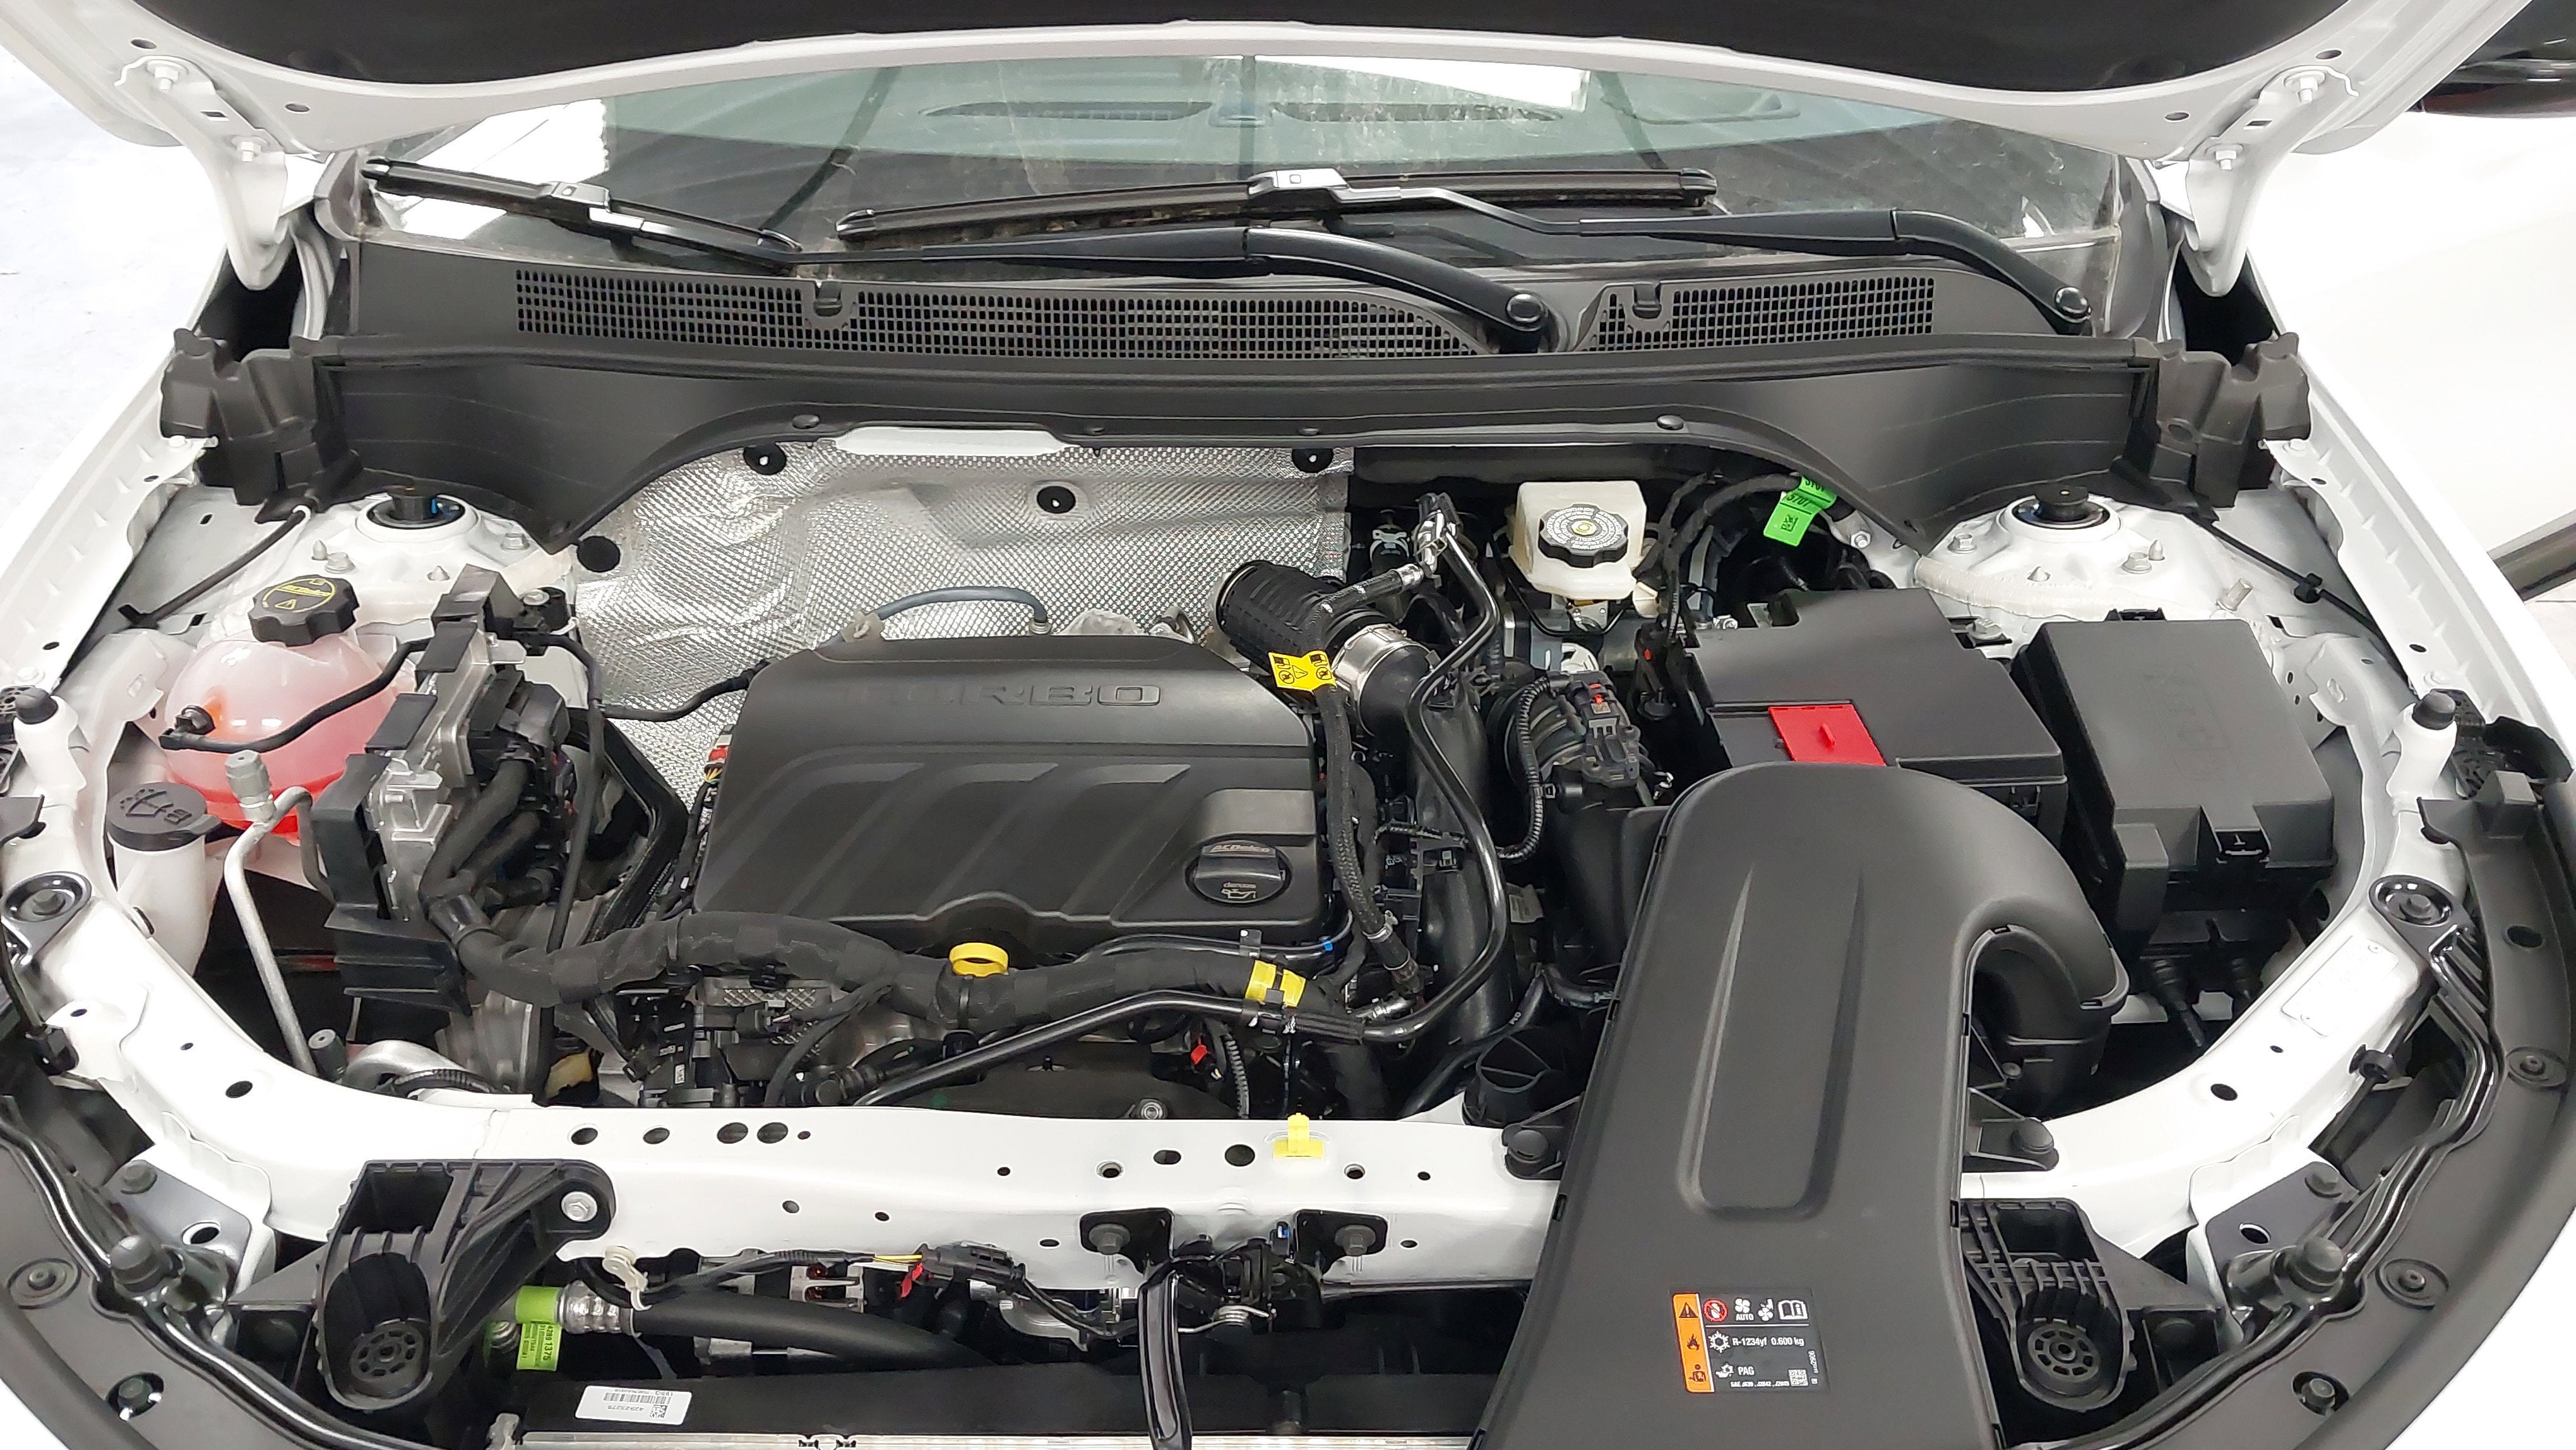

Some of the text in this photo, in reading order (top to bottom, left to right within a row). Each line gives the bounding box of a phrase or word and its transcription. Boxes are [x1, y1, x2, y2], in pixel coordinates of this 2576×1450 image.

[1736, 1313, 1755, 1321] AUTO
[1770, 1336, 1793, 1346] 0.600
[1793, 1336, 1805, 1346] kg
[1738, 1365, 1755, 1375] PAG
